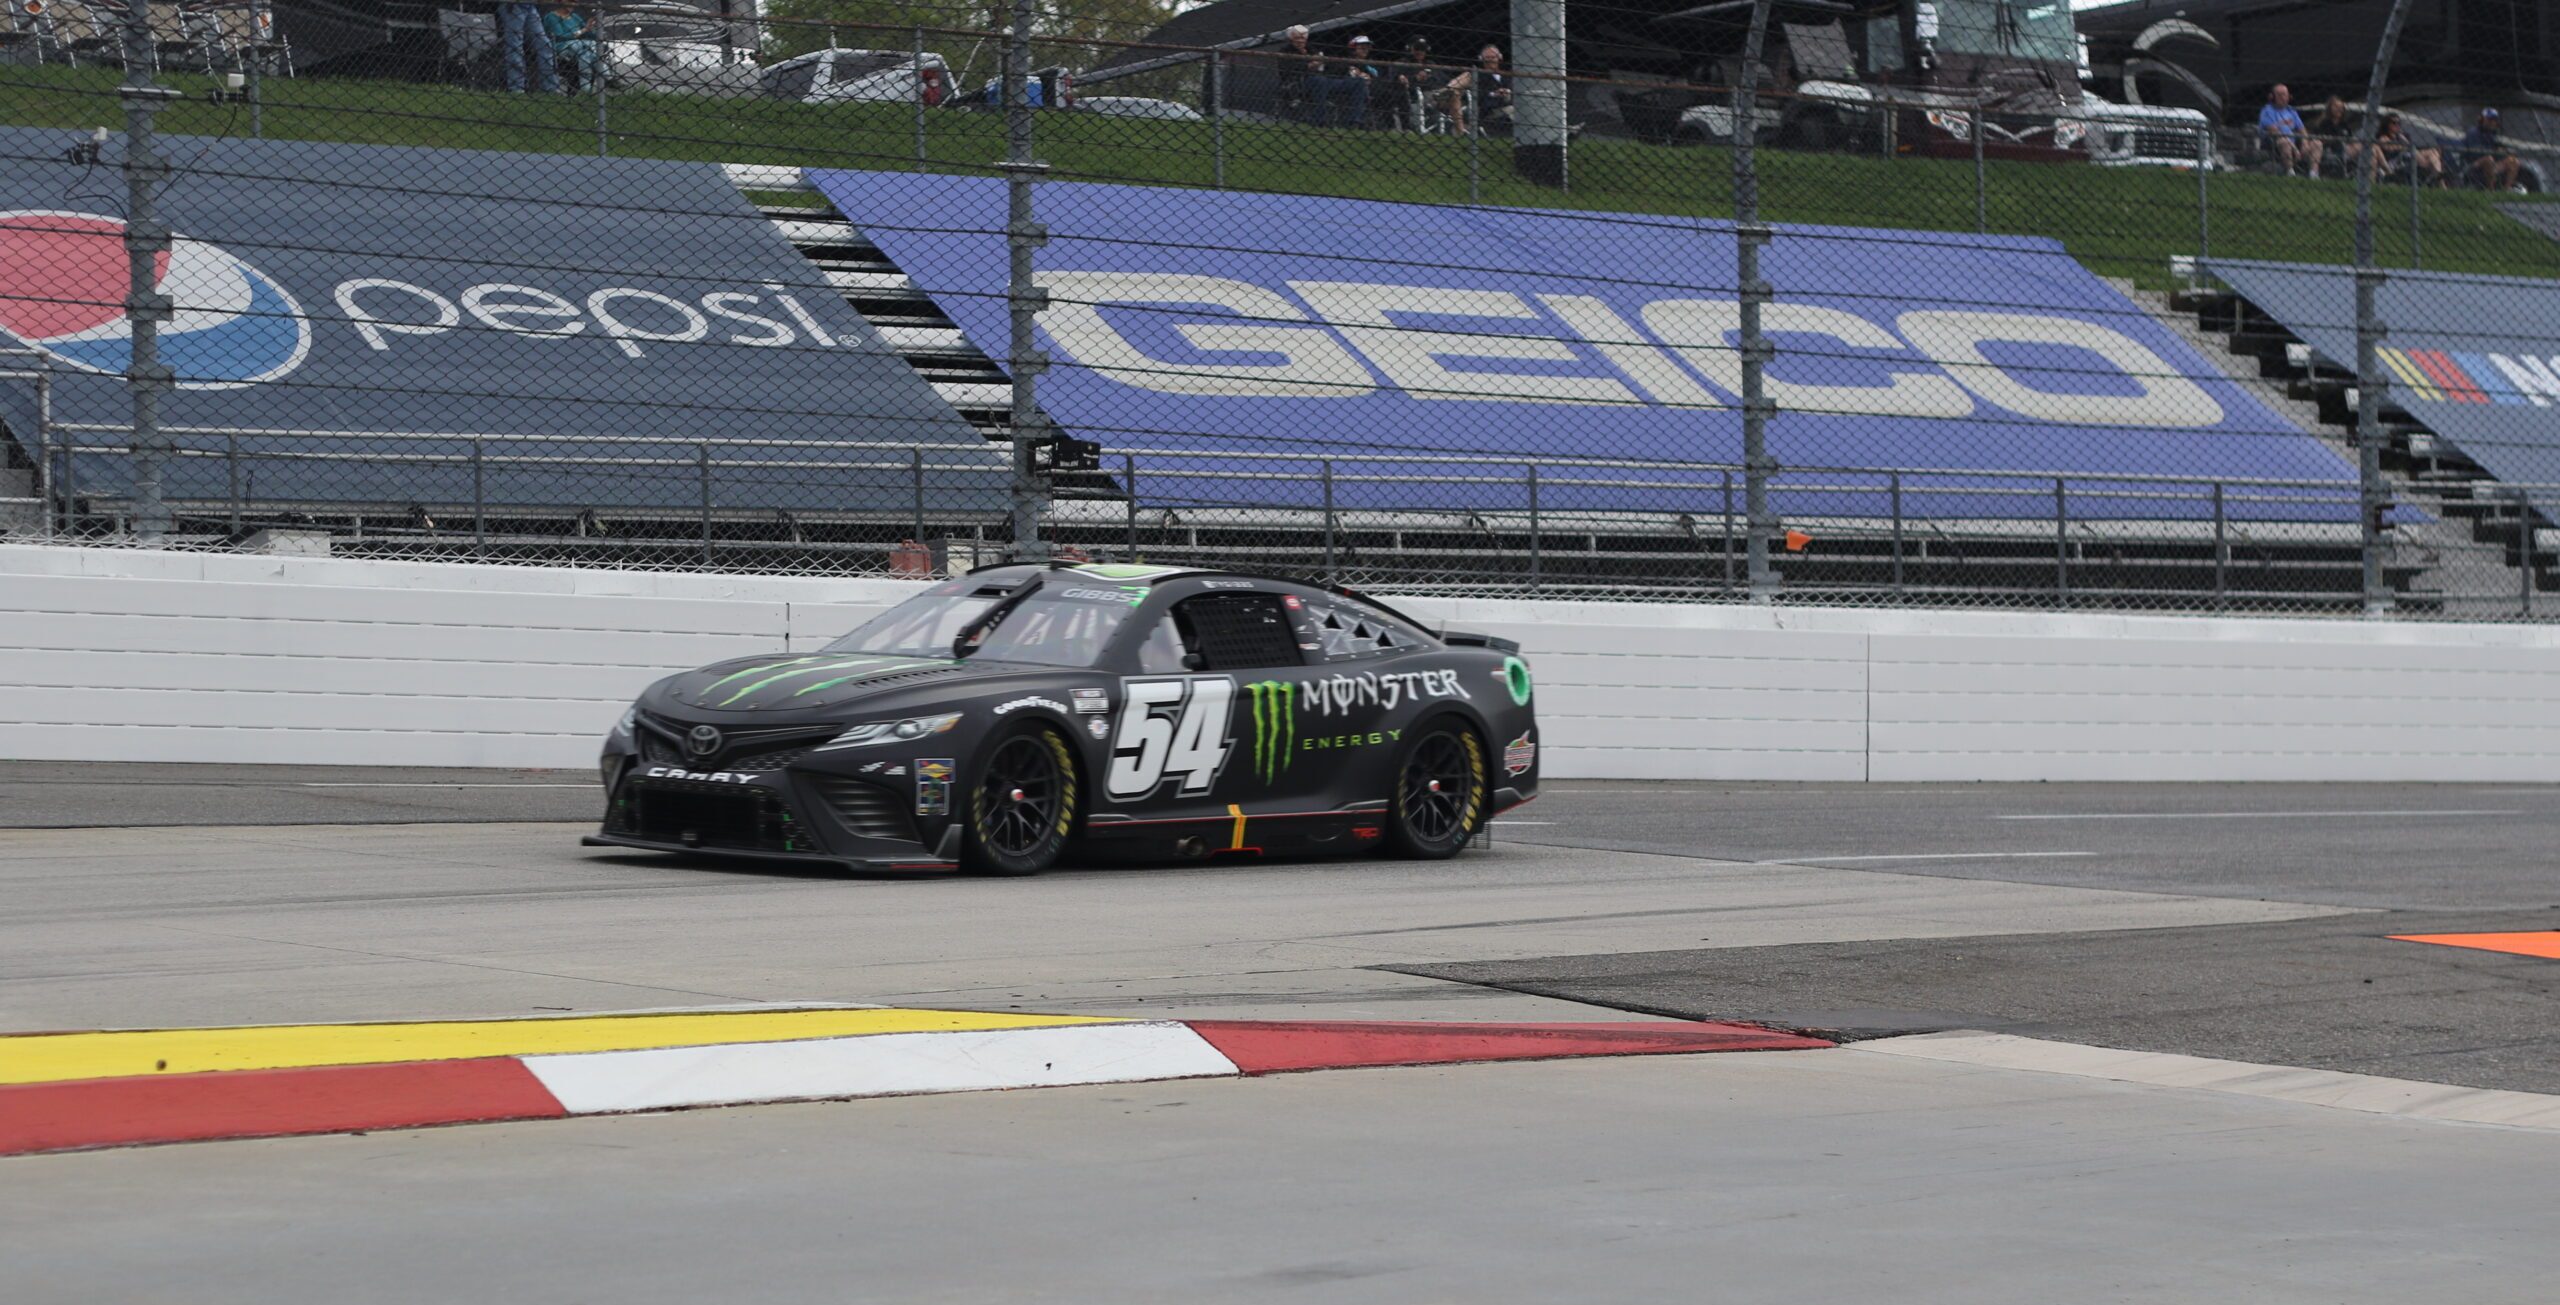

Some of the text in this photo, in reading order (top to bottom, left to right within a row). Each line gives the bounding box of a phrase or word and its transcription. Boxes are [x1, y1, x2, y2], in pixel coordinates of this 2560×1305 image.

[334, 277, 840, 359] pepsi
[1008, 270, 2225, 427] GEICO
[1301, 668, 1472, 717] MONSTER
[1106, 677, 1232, 798] 54
[1302, 727, 1402, 751] ENERGY
